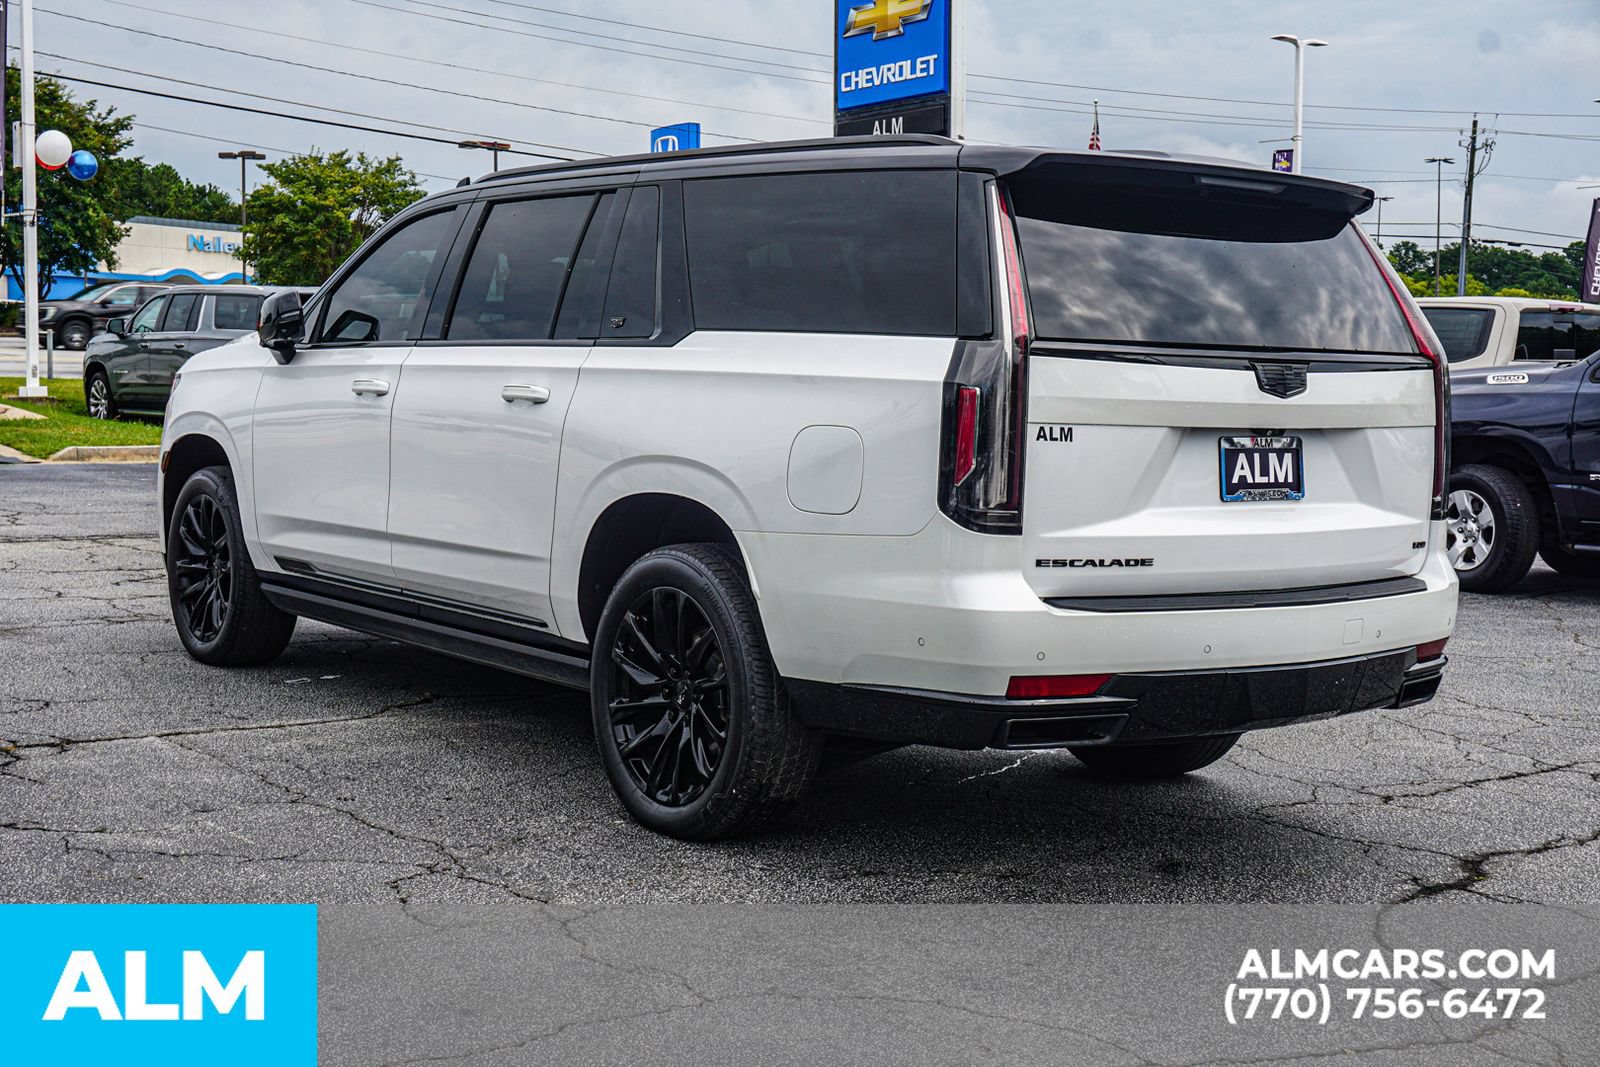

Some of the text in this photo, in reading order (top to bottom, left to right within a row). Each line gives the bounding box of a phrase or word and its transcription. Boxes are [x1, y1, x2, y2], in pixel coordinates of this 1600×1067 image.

[841, 54, 938, 92] CHEVROLET
[872, 116, 904, 136] ALM
[1036, 426, 1074, 442] ALM
[1253, 438, 1274, 448] ALM
[1231, 452, 1294, 483] ALM
[1035, 558, 1154, 568] ESCALADE
